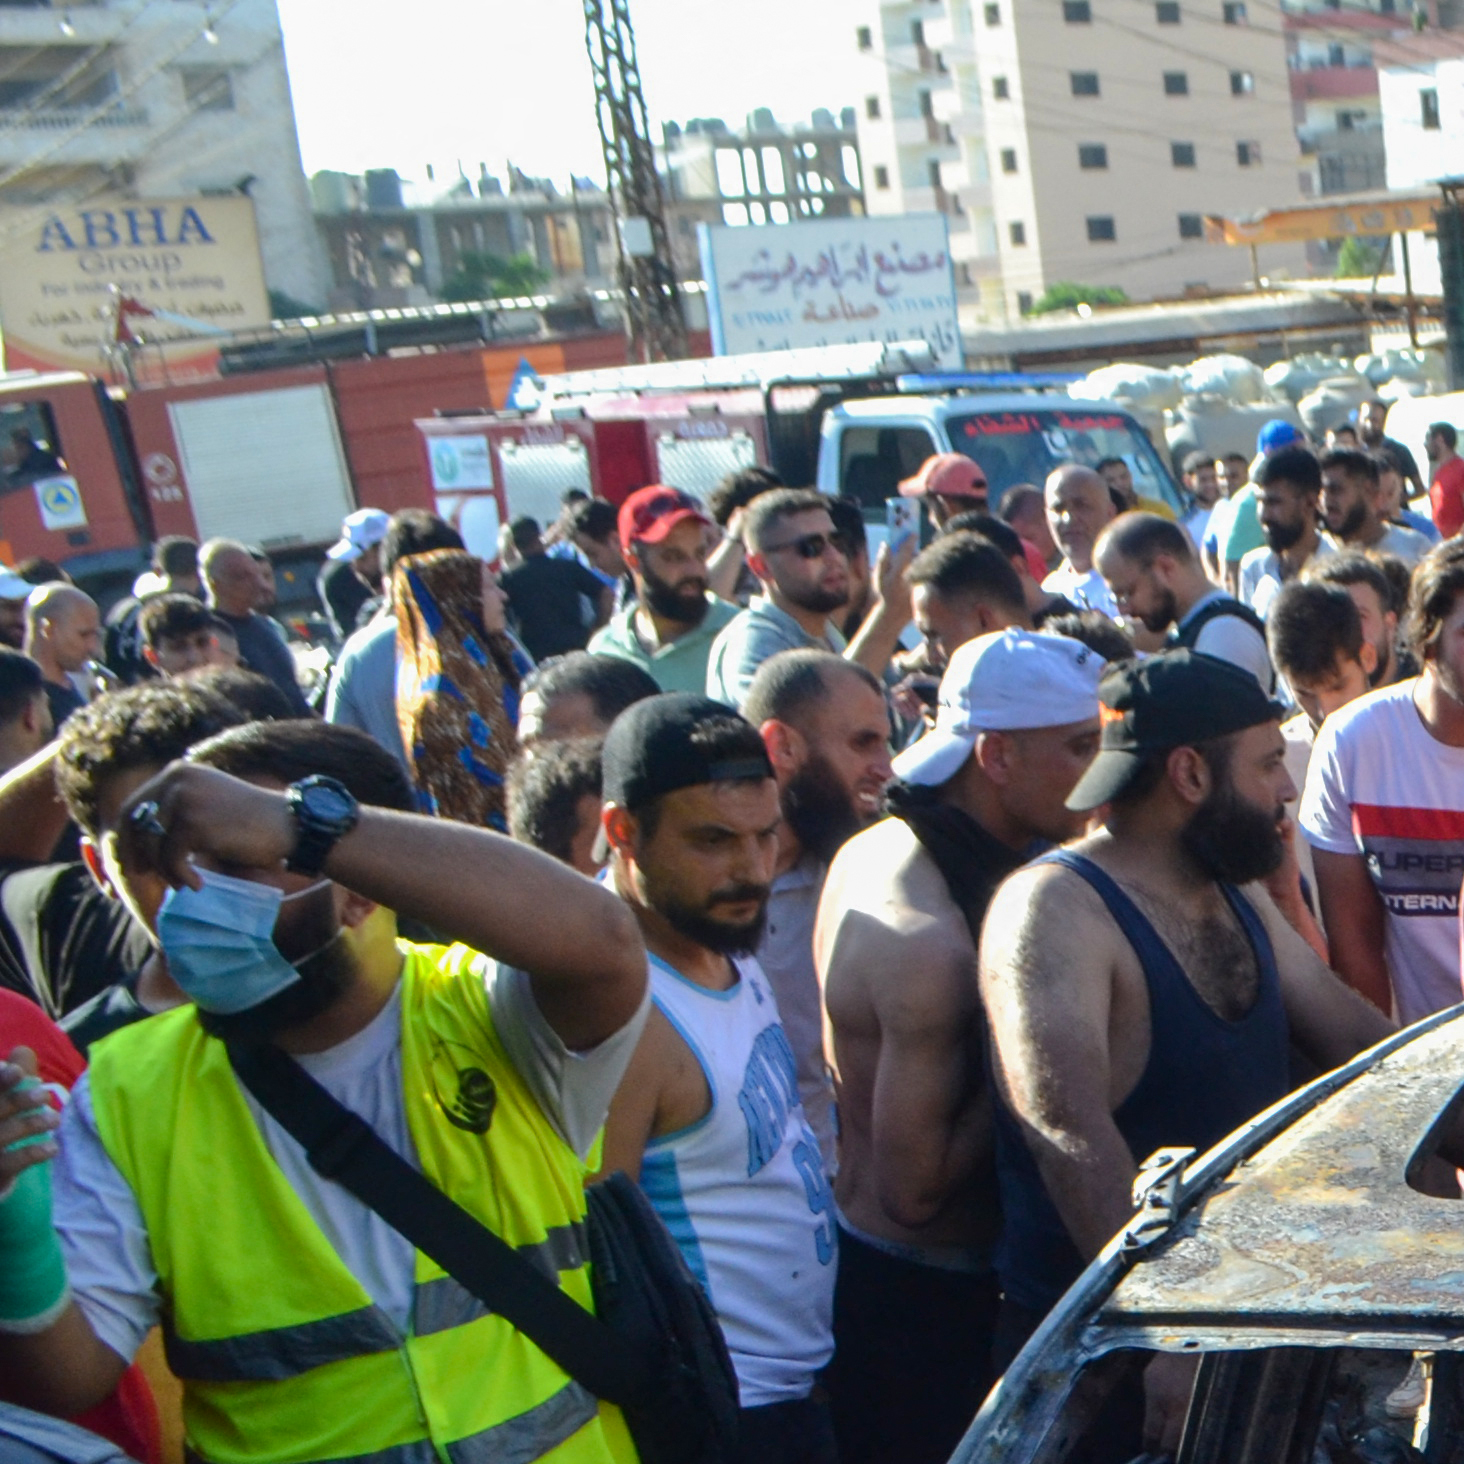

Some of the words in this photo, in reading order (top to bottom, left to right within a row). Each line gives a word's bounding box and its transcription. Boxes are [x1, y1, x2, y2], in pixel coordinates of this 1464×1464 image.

[36, 205, 217, 252] ABHA
[79, 251, 182, 275] Group
[874, 241, 947, 296] مصنع
[803, 292, 879, 323] صناعة
